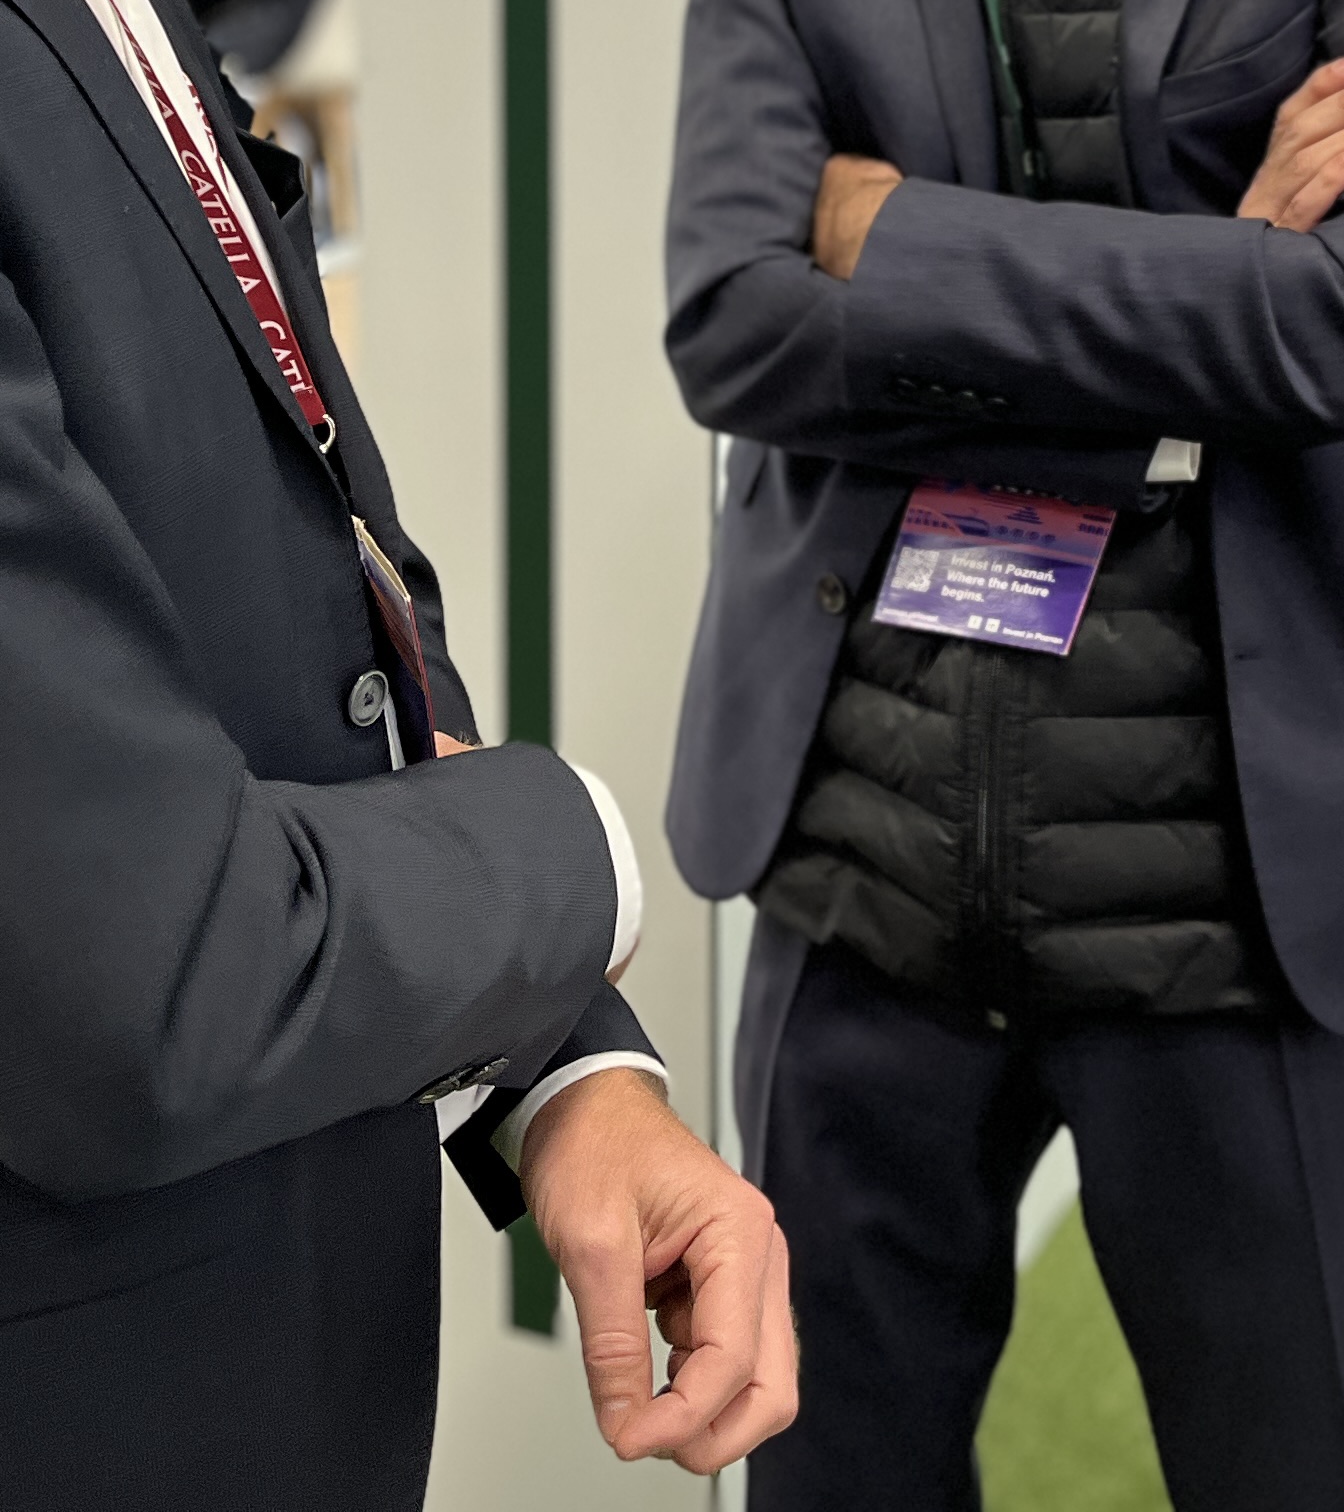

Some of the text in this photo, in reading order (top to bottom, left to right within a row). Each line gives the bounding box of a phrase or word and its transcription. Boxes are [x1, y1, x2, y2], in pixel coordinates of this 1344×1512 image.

[951, 554, 989, 571] Invest
[991, 561, 1003, 573] in
[947, 569, 1049, 597] Where the future
[941, 584, 984, 602] begins.
